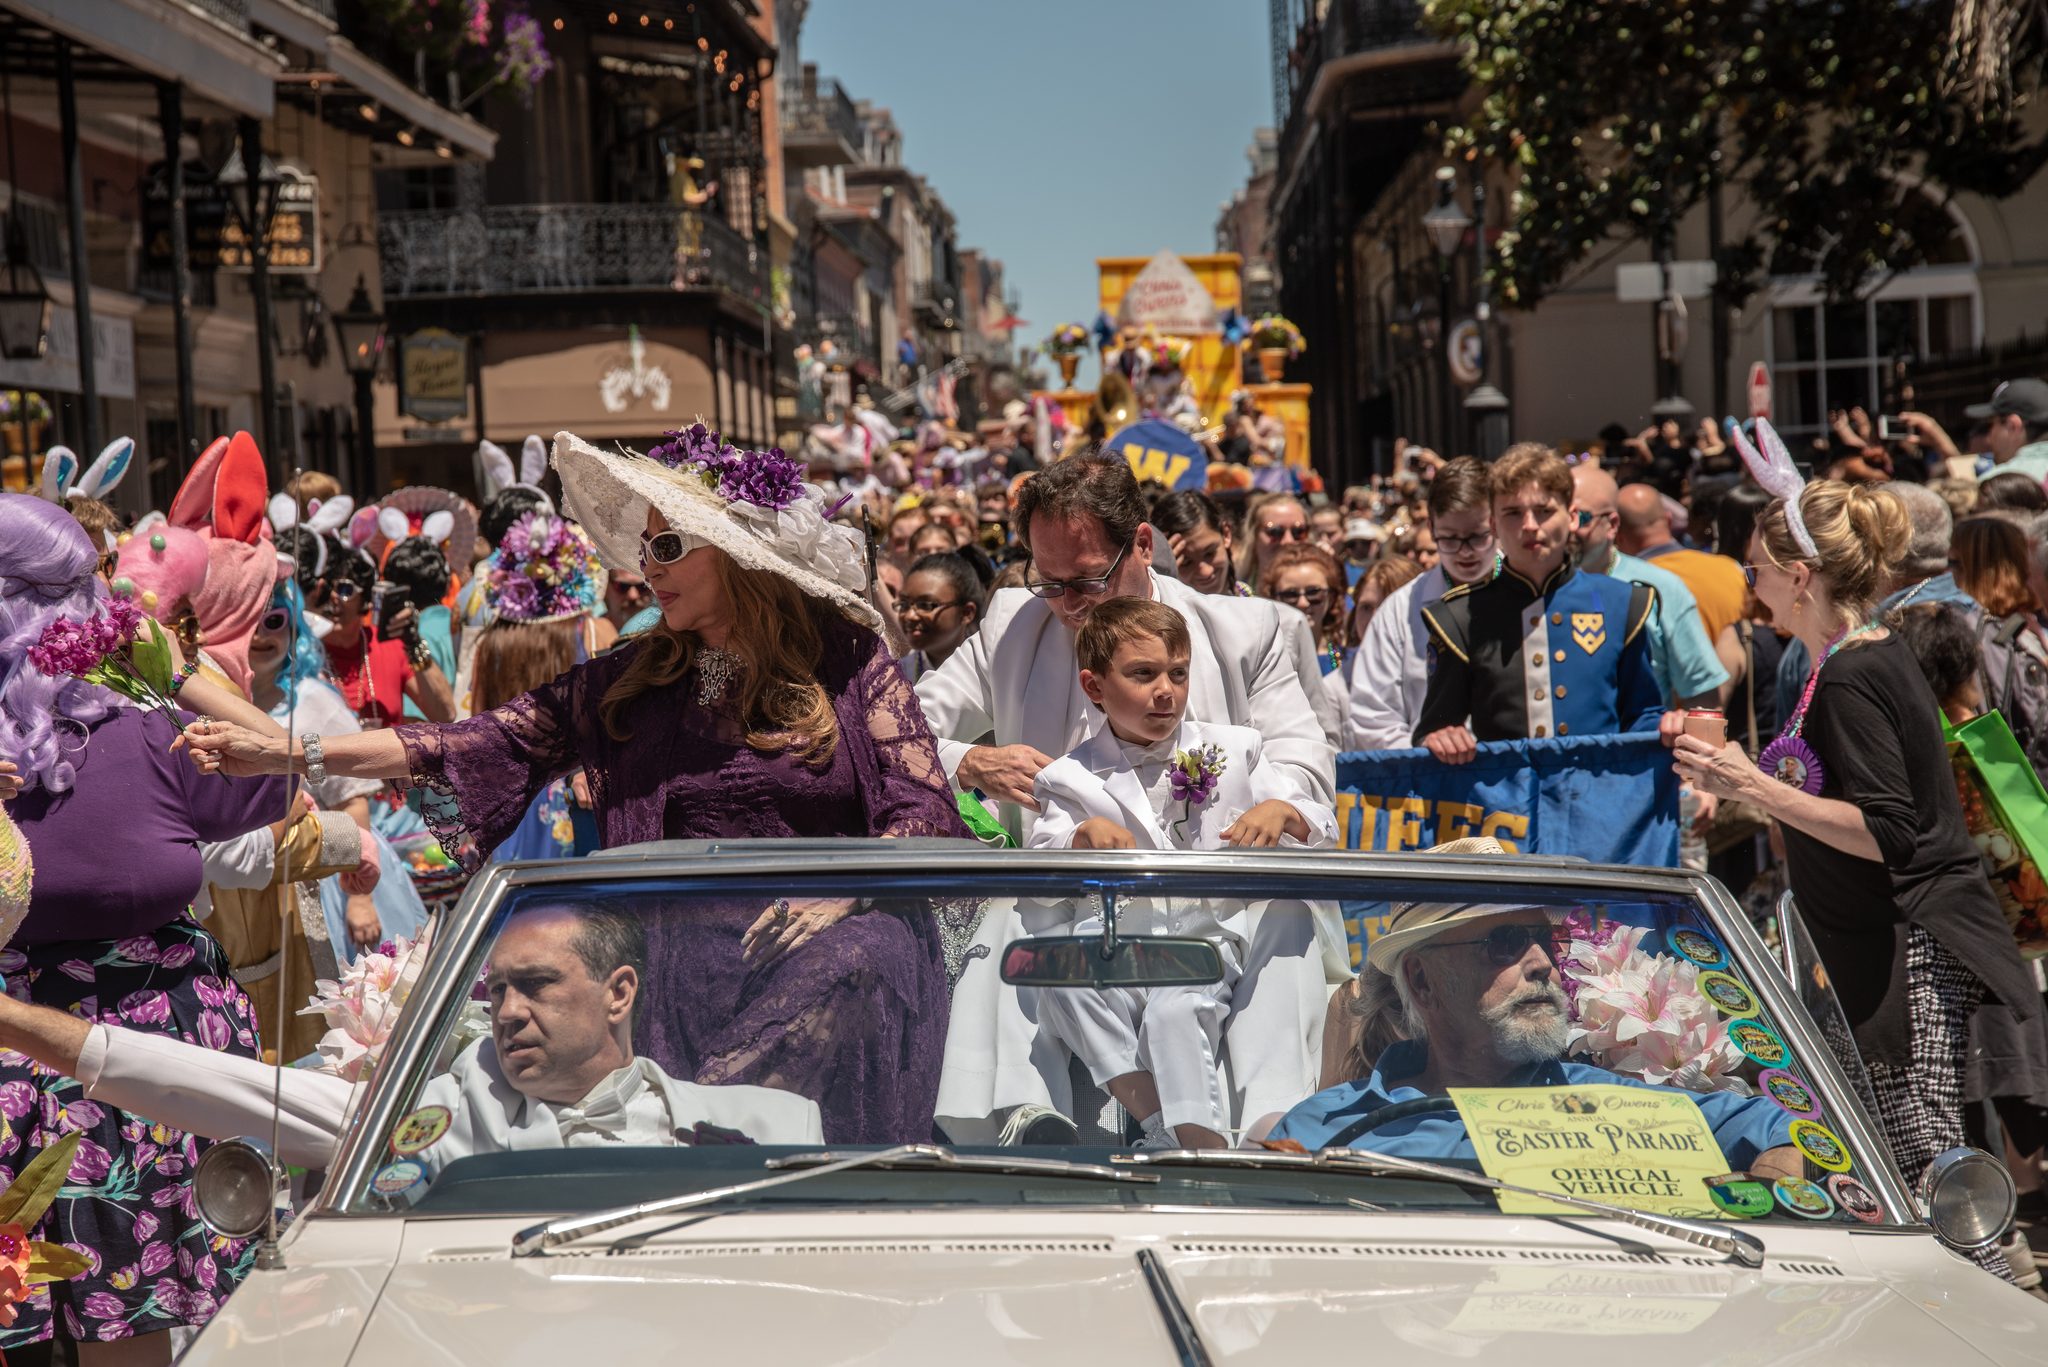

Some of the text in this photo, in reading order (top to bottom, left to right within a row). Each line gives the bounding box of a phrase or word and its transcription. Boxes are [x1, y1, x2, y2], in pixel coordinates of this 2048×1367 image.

[1123, 442, 1191, 490] W
[1498, 1098, 1545, 1113] Chris
[1495, 1122, 1704, 1157] EASTER PARADE
[1551, 1167, 1681, 1183] OFFICIAL
[1559, 1180, 1683, 1197] VEHICLE
